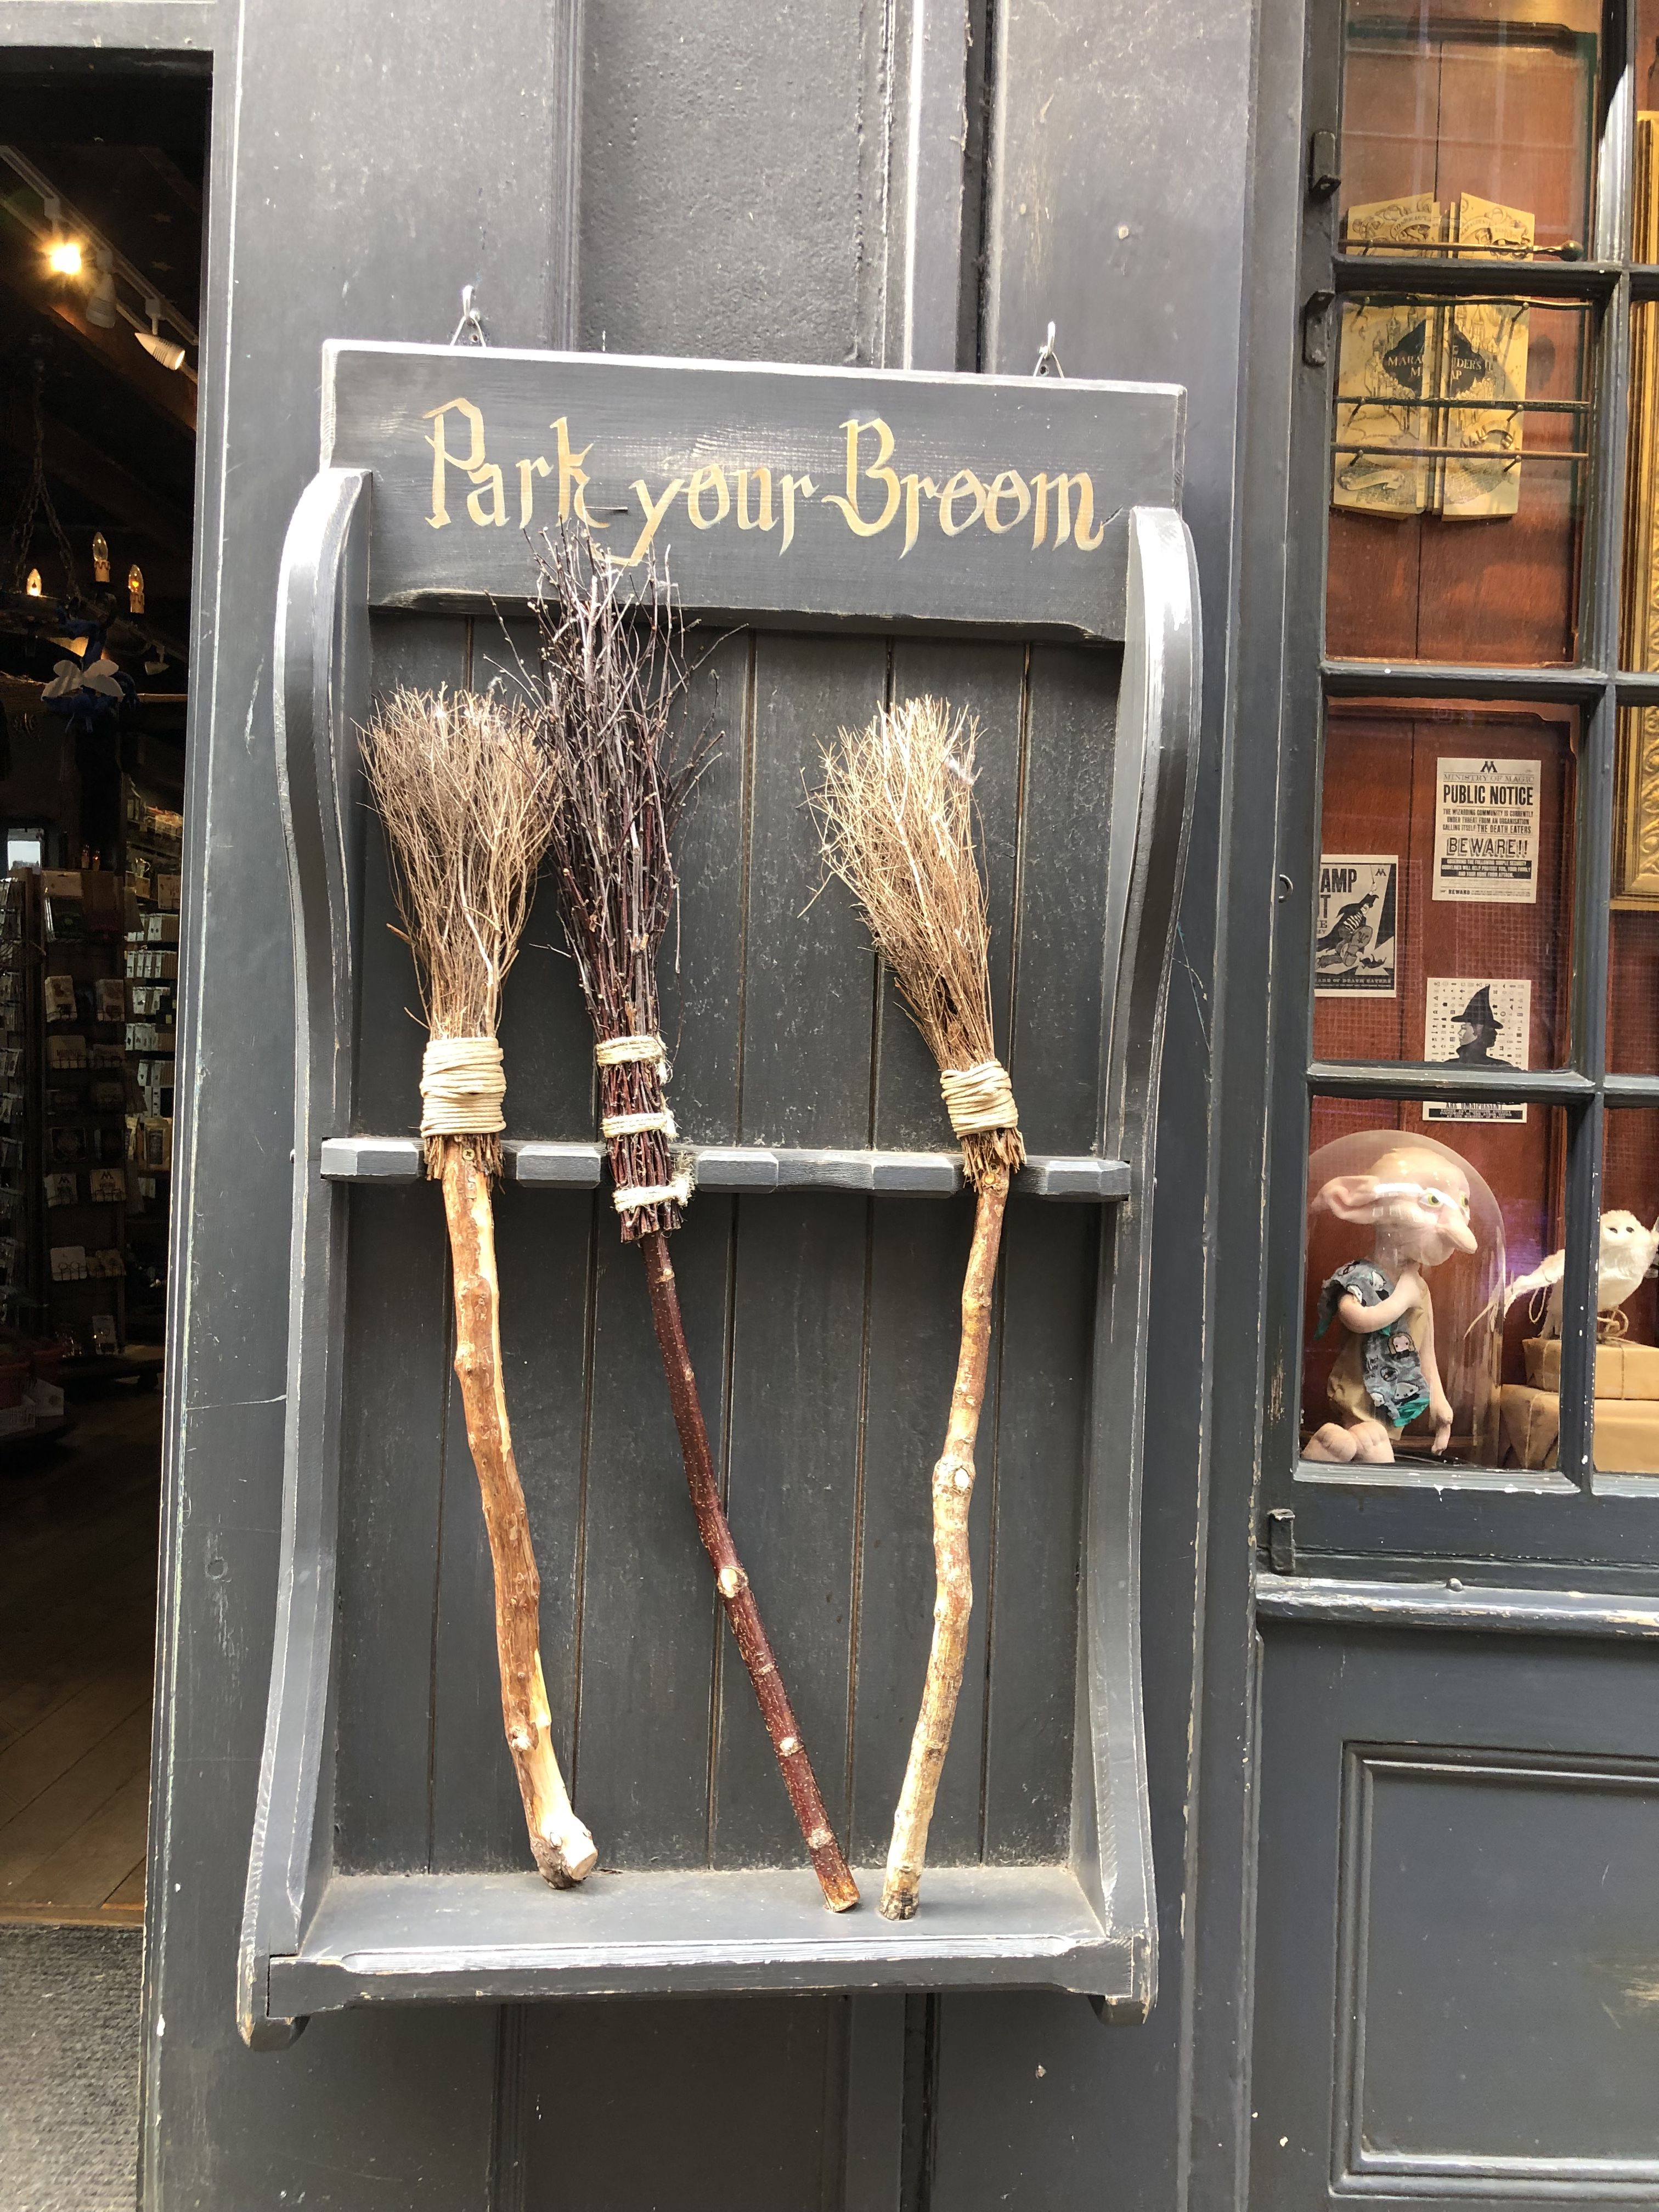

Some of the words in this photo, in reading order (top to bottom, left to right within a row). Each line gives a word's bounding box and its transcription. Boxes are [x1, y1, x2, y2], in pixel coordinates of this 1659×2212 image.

[422, 397, 610, 529] Park
[590, 462, 820, 567] your
[822, 417, 1104, 560] Broom
[1443, 785, 1485, 804] PUBLIC
[1490, 786, 1533, 805] NOTICE
[1477, 825, 1487, 833] THE
[1490, 825, 1508, 833] DEATH
[1510, 825, 1531, 834] EATERS
[1447, 837, 1528, 858] BEWARE!!
[1321, 868, 1357, 893] AMP
